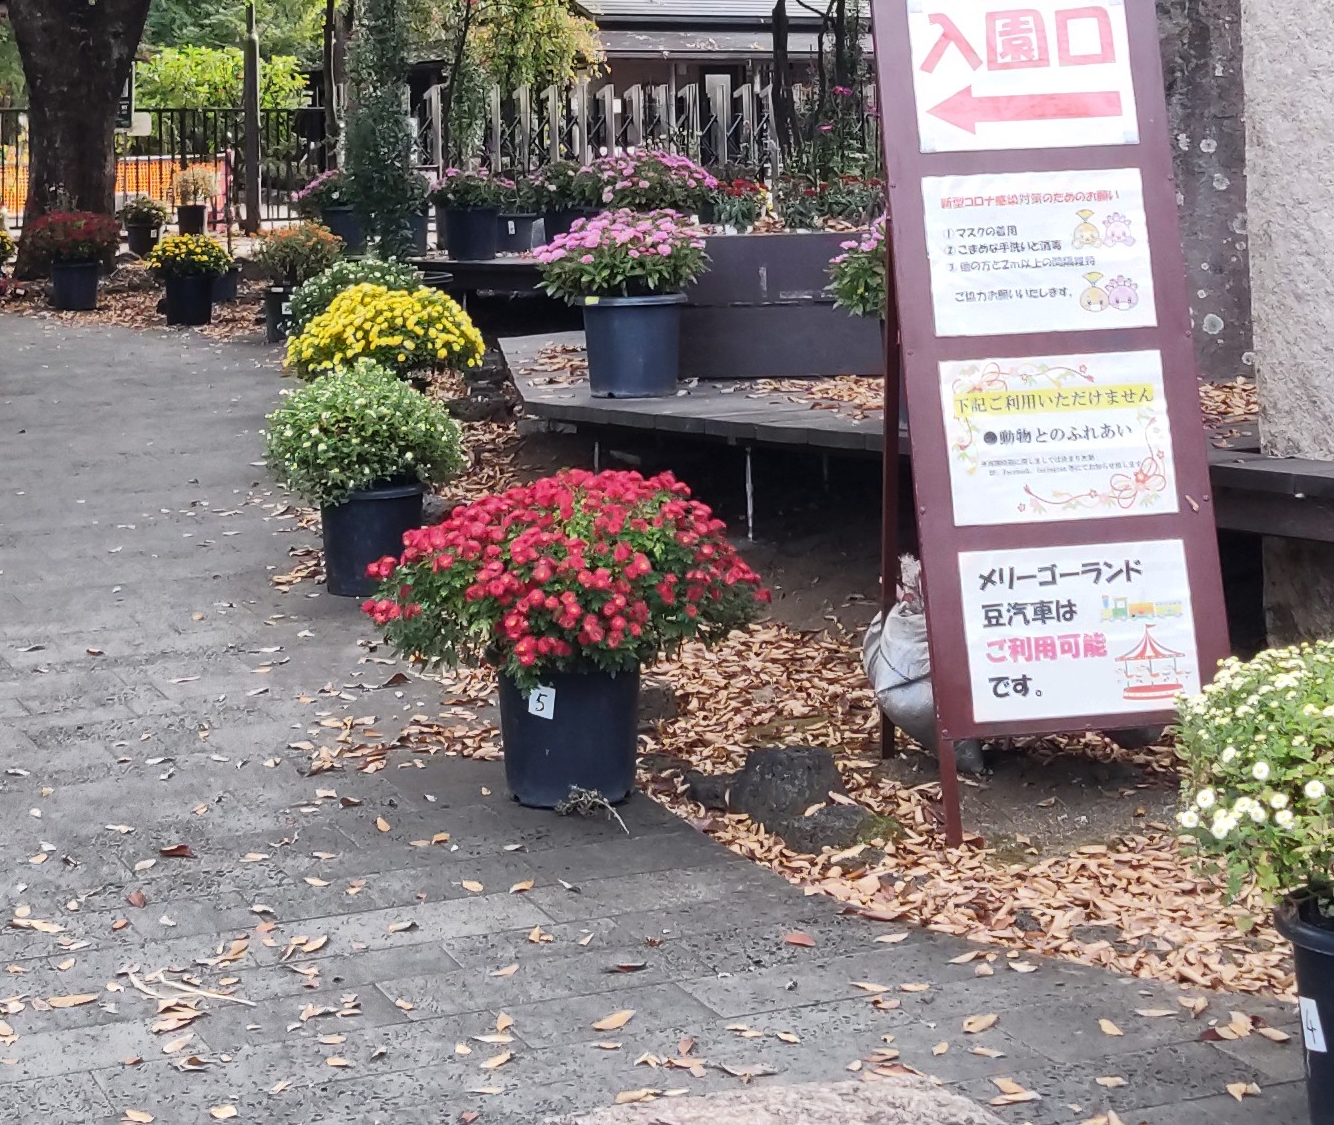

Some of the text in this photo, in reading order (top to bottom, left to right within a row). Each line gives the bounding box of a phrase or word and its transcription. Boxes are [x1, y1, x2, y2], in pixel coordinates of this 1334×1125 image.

[919, 5, 1116, 74] 入園口
[955, 386, 1154, 415] 下記ご利用いただけません
[978, 559, 1143, 591] メリーゴーランド
[981, 599, 1078, 629] 豆汽車は
[985, 631, 1108, 663] ご利用可能
[988, 674, 1044, 699] です。
[535, 693, 548, 712] 5
